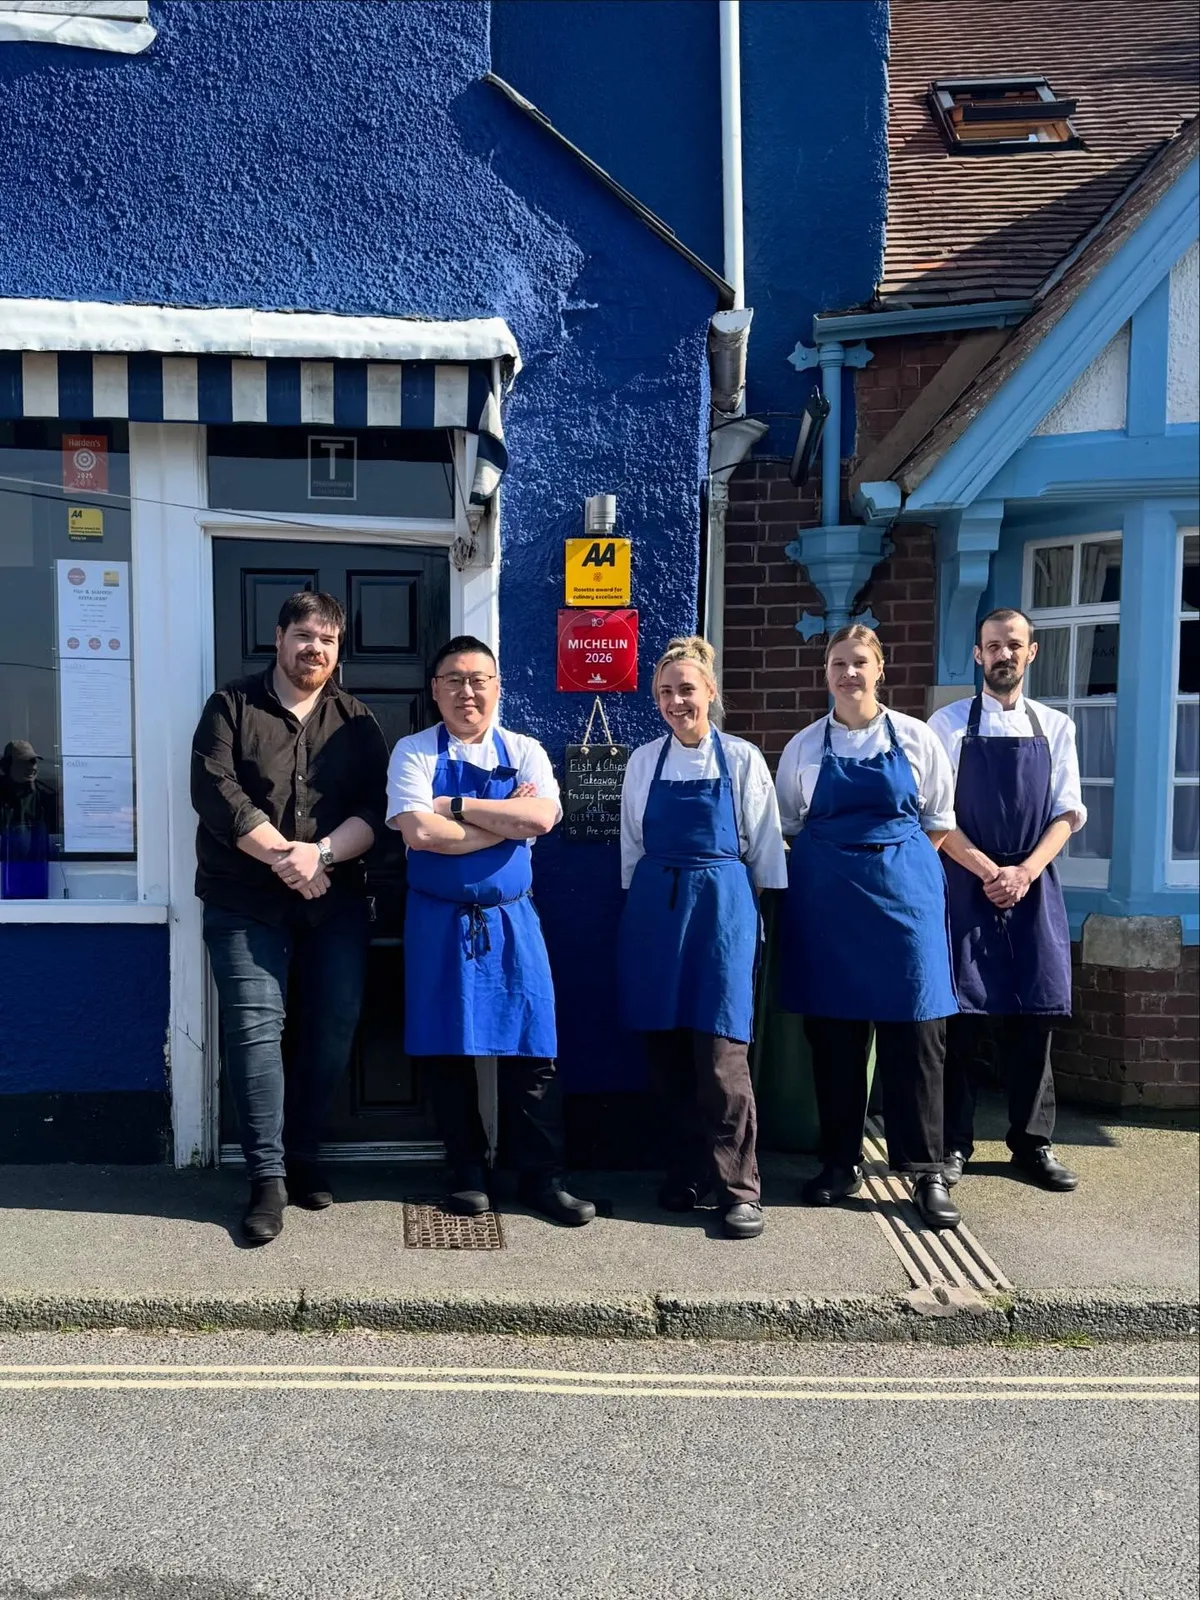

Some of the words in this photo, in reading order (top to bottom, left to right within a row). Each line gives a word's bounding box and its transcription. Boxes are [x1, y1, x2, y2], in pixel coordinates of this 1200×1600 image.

[68, 438, 101, 448] Harden's
[321, 444, 344, 480] T
[71, 510, 83, 519] AA
[581, 542, 616, 567] AA
[568, 639, 628, 649] MICHELIN
[585, 652, 613, 663] 2026
[570, 758, 593, 772] Fish
[603, 758, 627, 775] Chips
[568, 788, 595, 803] Friday
[586, 802, 605, 813] Call
[600, 813, 620, 823] 8760
[569, 826, 577, 835] To
[586, 825, 621, 836] Pre-orde
